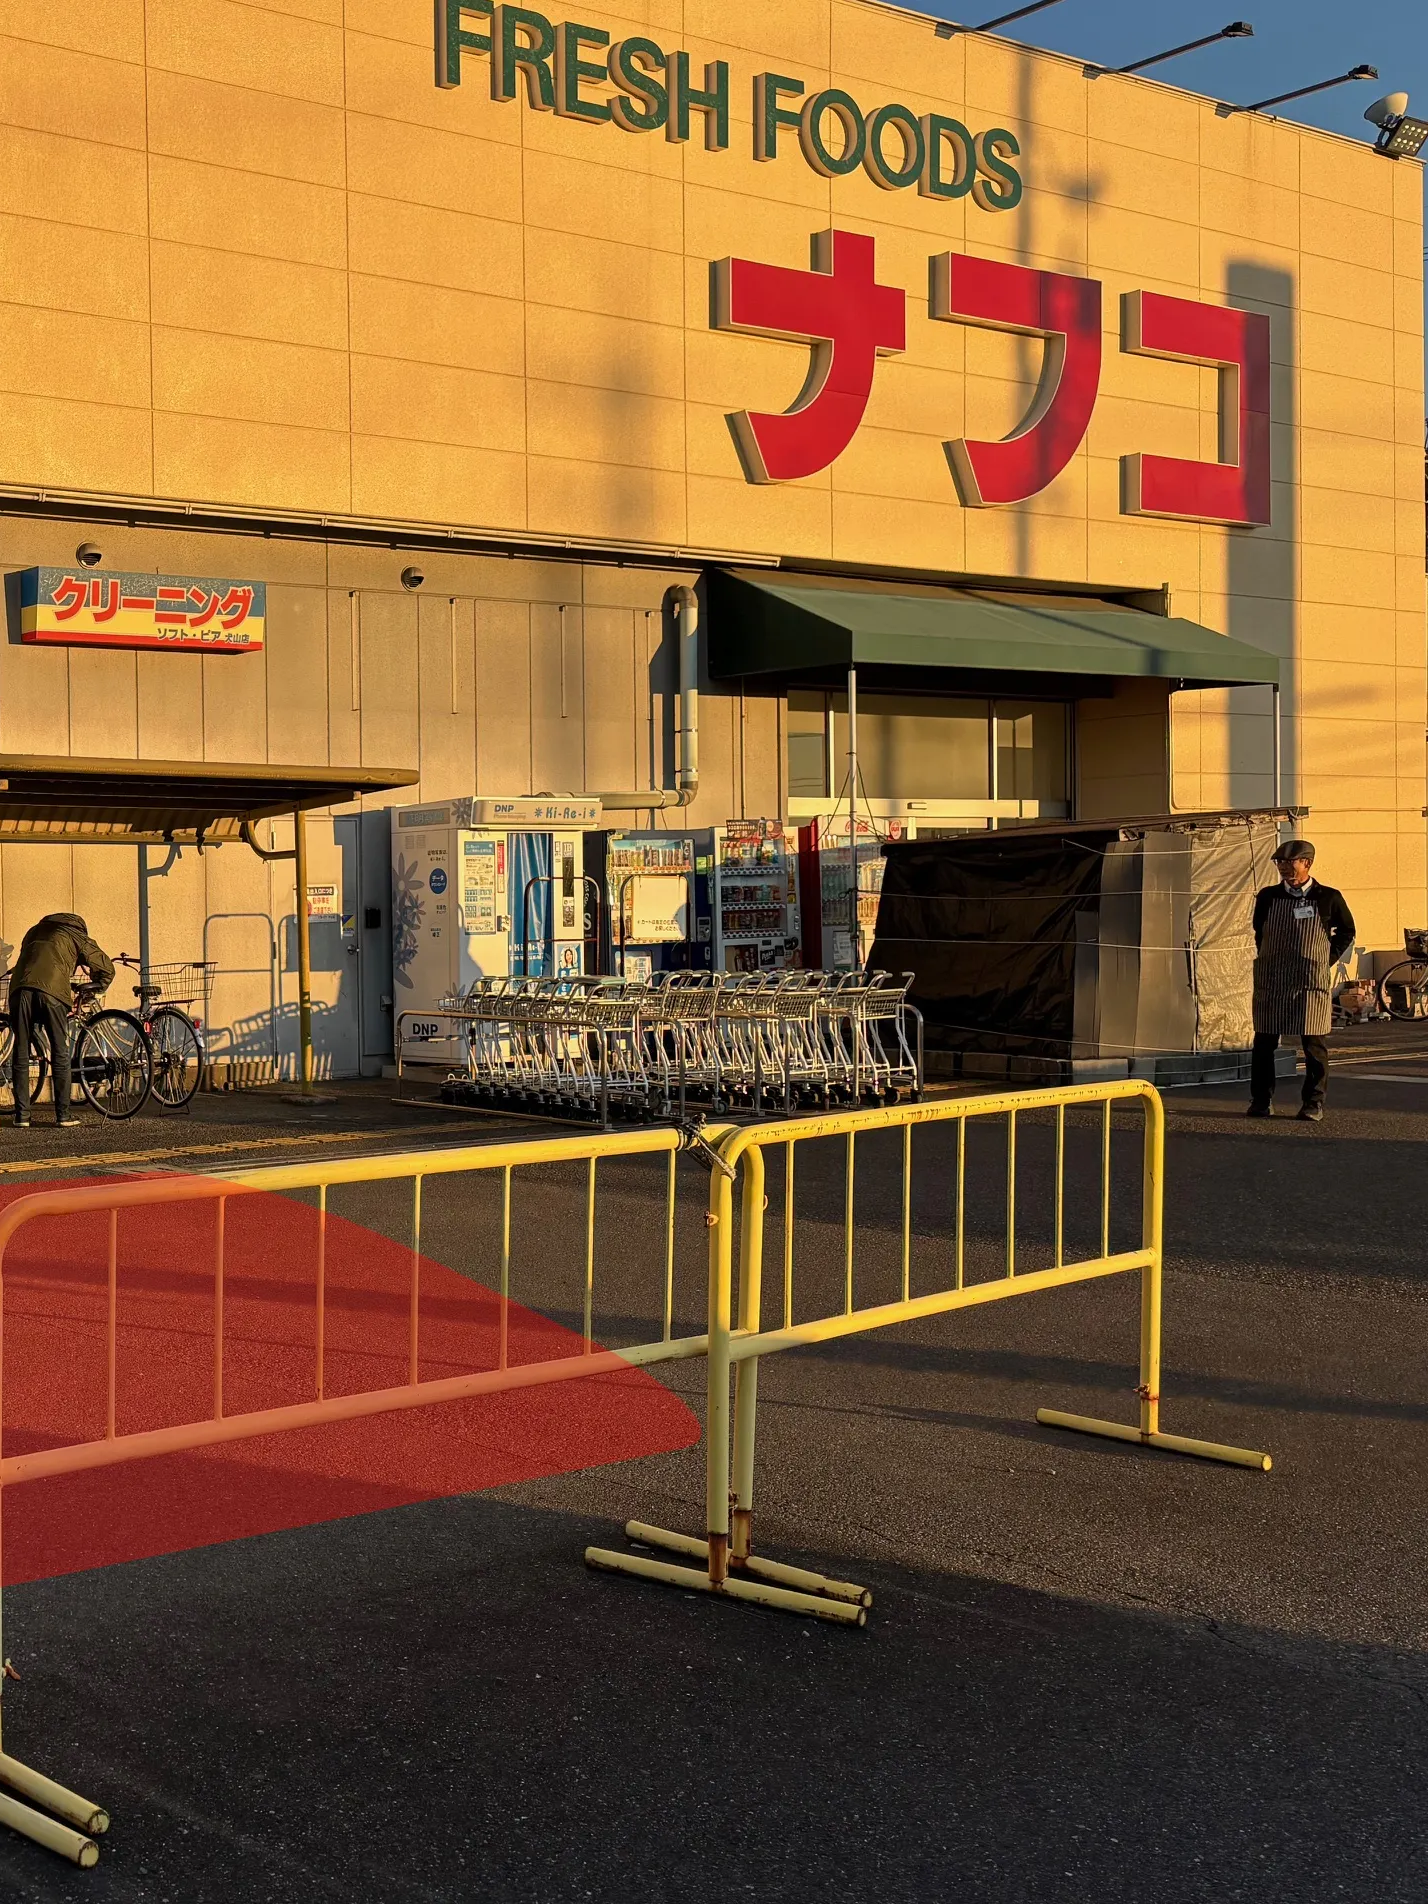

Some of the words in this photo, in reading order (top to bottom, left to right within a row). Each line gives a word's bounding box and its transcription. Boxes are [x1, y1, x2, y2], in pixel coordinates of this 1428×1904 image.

[434, 0, 728, 152] FRESH
[753, 72, 1022, 212] FOODS
[710, 228, 1270, 528] ナフコ
[52, 576, 254, 630] クリーニング
[157, 627, 221, 643] ソフト・ピア
[225, 633, 250, 644] 犬山店
[494, 804, 515, 813] DNP
[545, 806, 587, 819] Ki-Re-i
[412, 1023, 439, 1036] DNP
